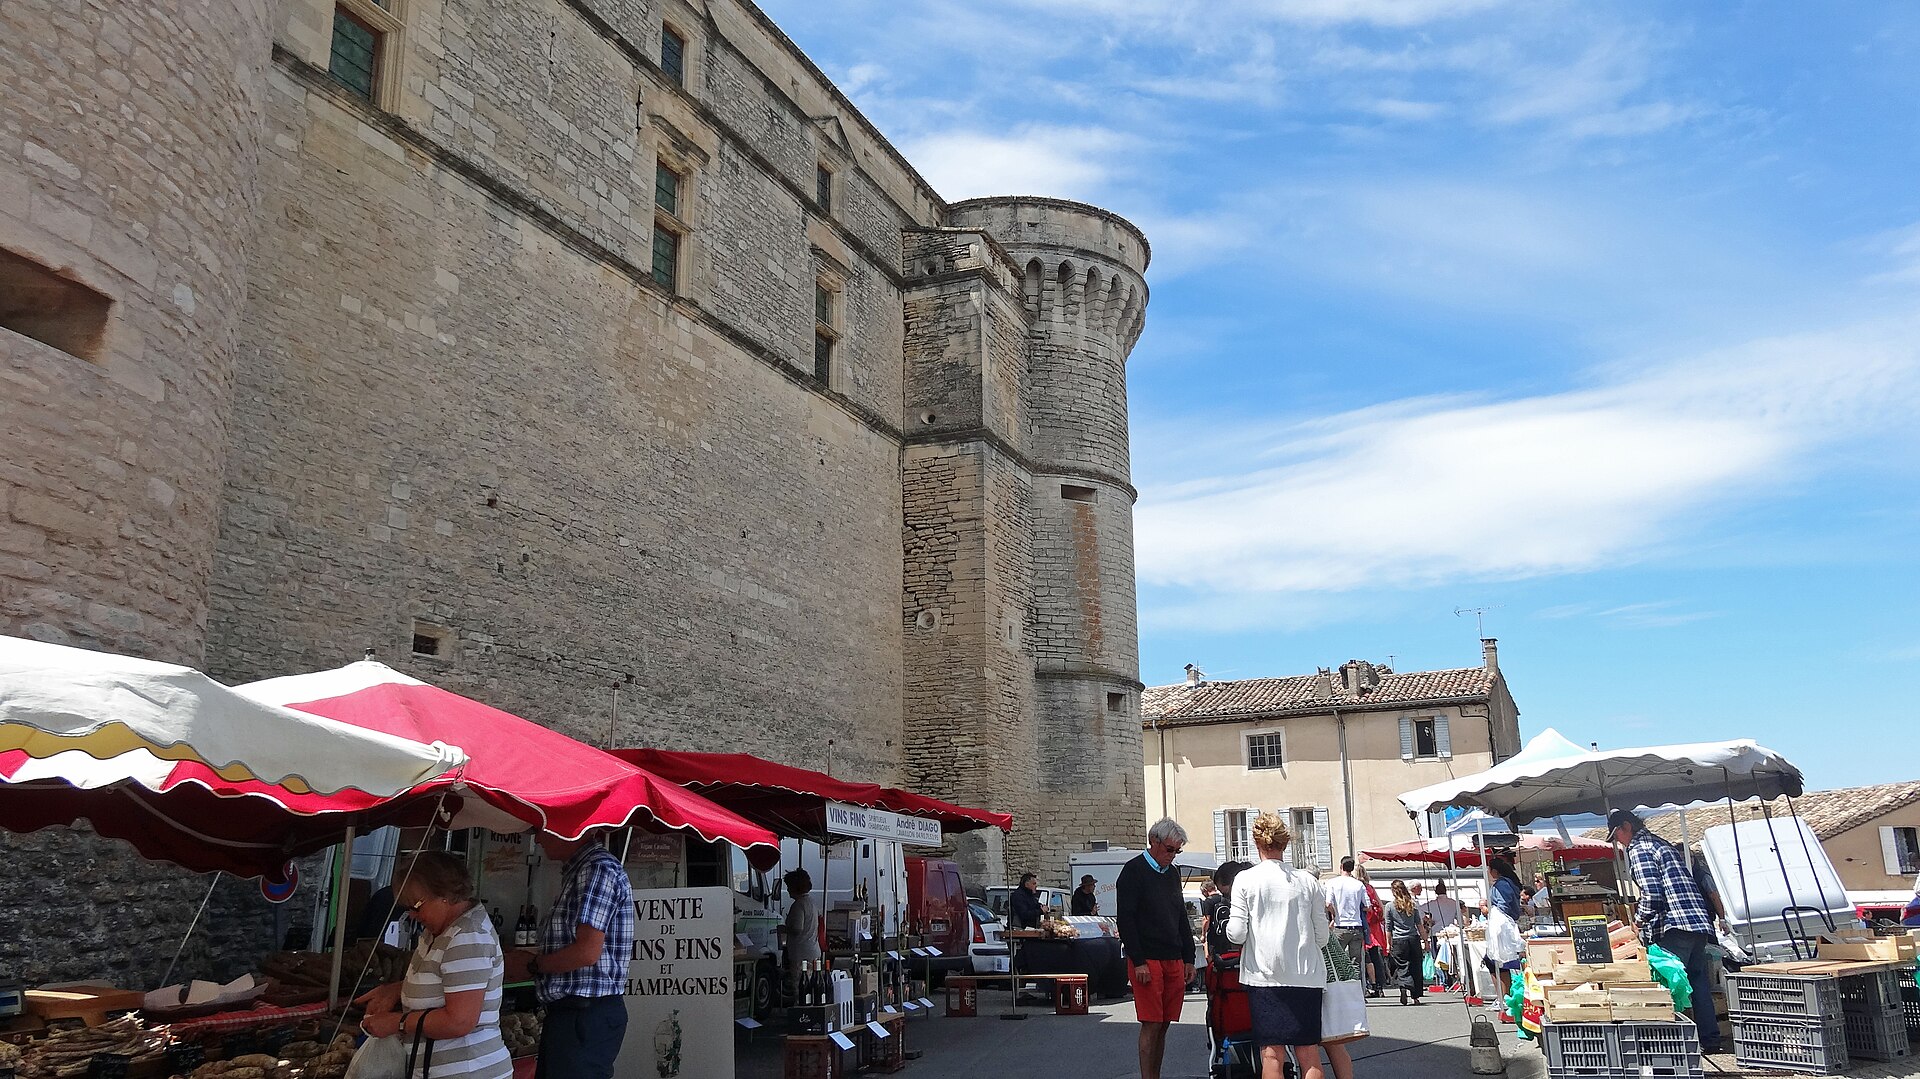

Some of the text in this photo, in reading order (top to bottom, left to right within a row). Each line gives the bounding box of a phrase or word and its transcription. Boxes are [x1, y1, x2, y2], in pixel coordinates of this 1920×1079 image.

[829, 807, 866, 828] VINS FINS
[896, 817, 939, 833] André DIAGO
[634, 898, 704, 920] VENTE
[660, 924, 676, 935] DE
[632, 937, 722, 961] INS FINS
[660, 964, 675, 975] ET
[625, 976, 728, 996] HAMPAGNES
